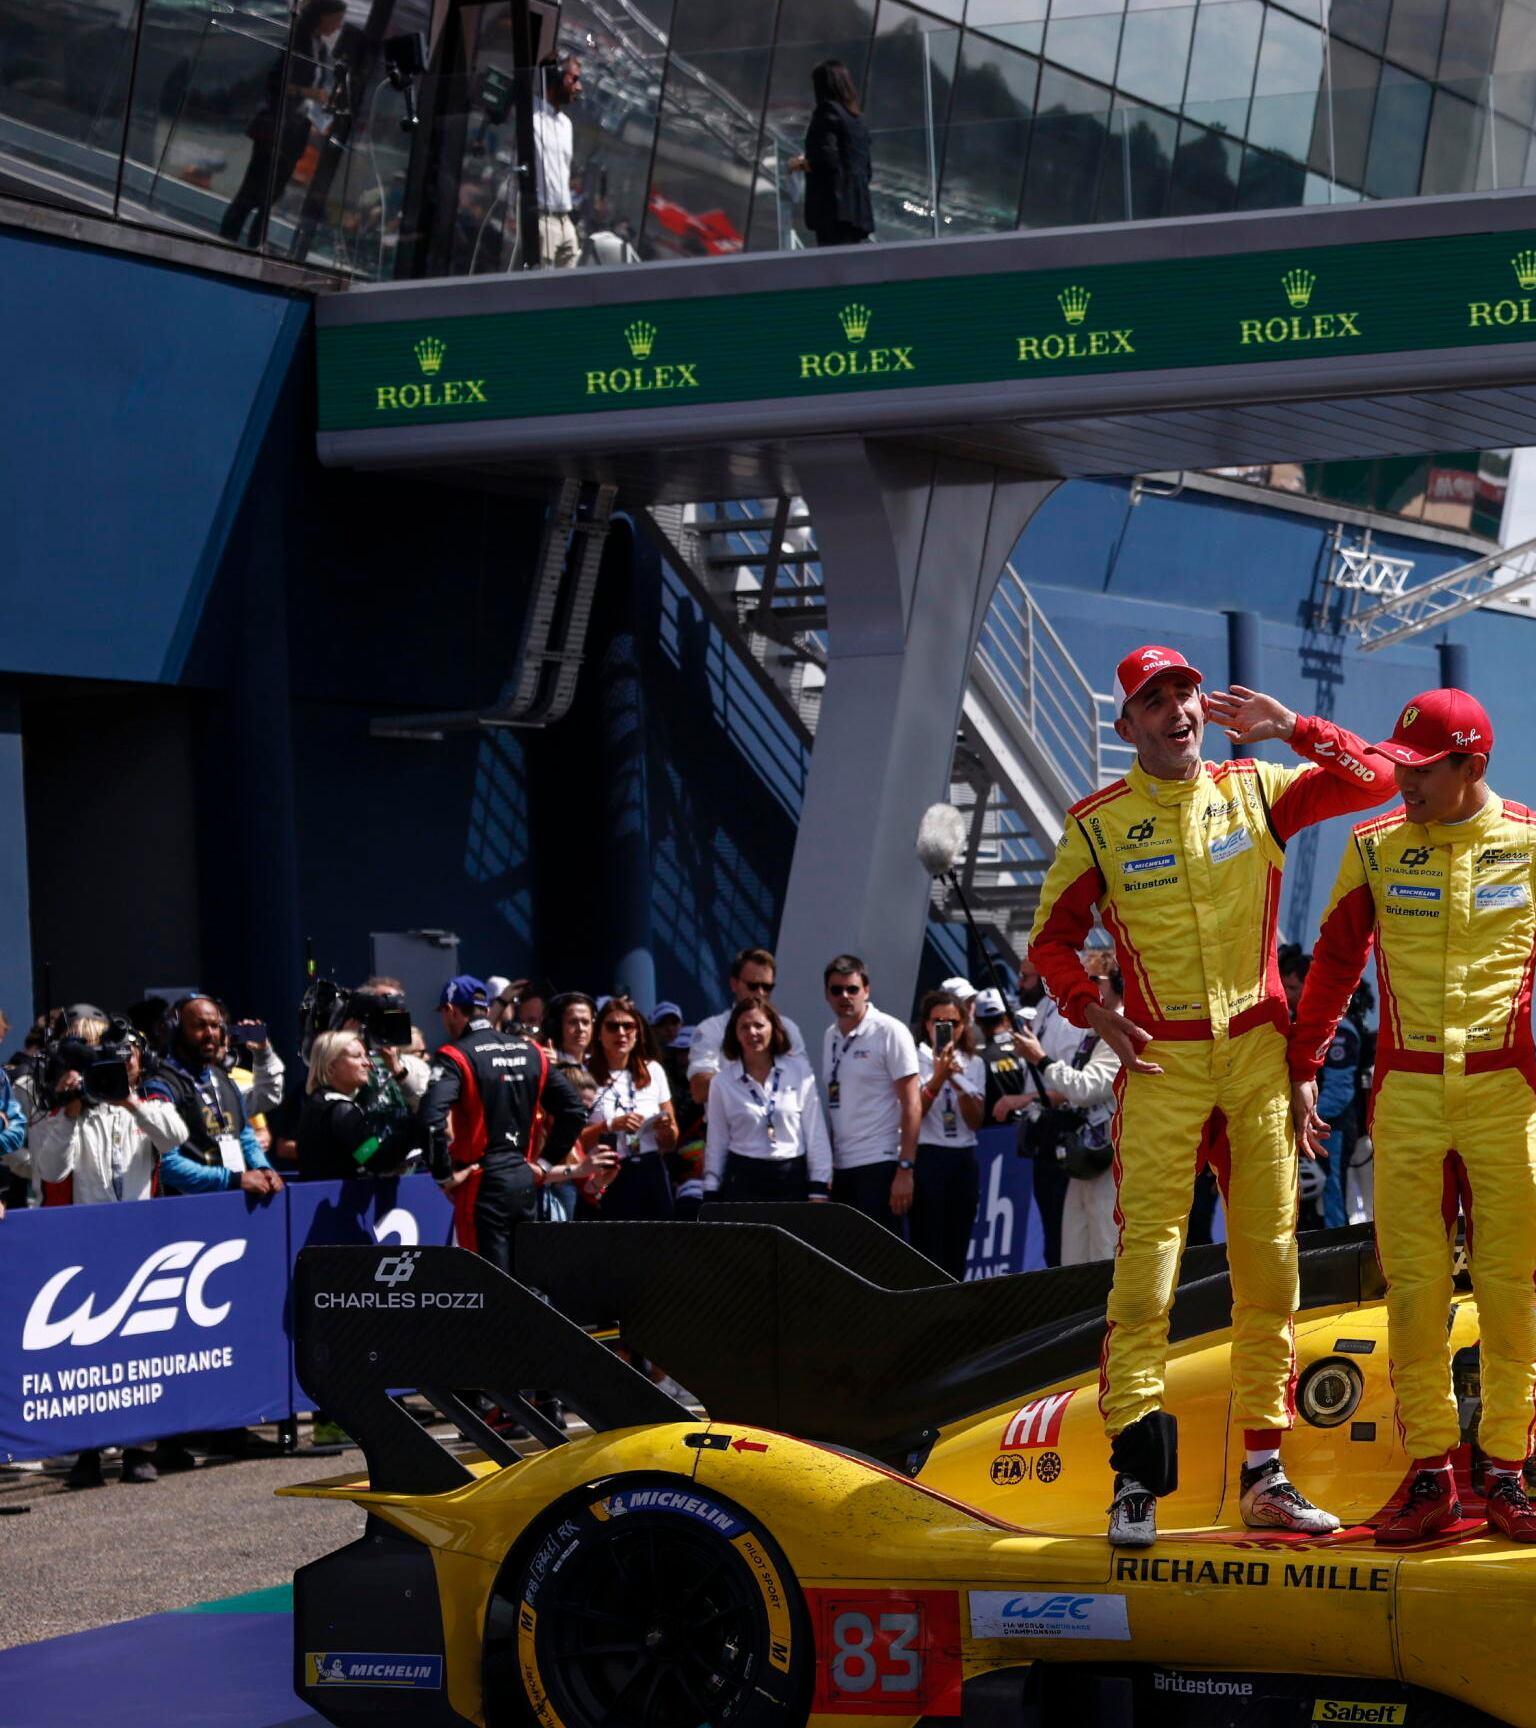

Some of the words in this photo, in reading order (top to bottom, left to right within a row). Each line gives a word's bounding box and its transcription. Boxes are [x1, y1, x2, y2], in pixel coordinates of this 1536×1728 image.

[1240, 311, 1361, 344] ROLEX
[1018, 329, 1135, 361] ROLEX
[799, 347, 914, 378] ROLEX
[586, 363, 698, 394] ROLEX
[376, 379, 487, 410] ROLEX
[1142, 659, 1171, 672] ORLEN
[1452, 728, 1482, 746] Ray-Ban
[1386, 905, 1440, 918] Britestone
[22, 1238, 247, 1351] WEC
[314, 1292, 416, 1310] CHARLES
[422, 1293, 485, 1310] POZZI
[22, 1374, 53, 1397] FIA
[57, 1364, 123, 1392] WORLD
[128, 1346, 234, 1380] ENDURANCE
[22, 1384, 163, 1423] CHAMPIONSHIP
[1004, 1390, 1075, 1446] HY
[629, 1491, 735, 1531] MICHELIN
[743, 1540, 766, 1572] PILOT
[761, 1570, 781, 1610] SPORT
[1116, 1557, 1269, 1587] RICHARD
[1283, 1563, 1390, 1593] MILLE
[1002, 1596, 1095, 1620] WEC
[831, 1612, 921, 1693] 83
[349, 1660, 433, 1680] MICHELIN
[1154, 1671, 1253, 1696] Britestone
[1321, 1702, 1397, 1726] Sabelt
